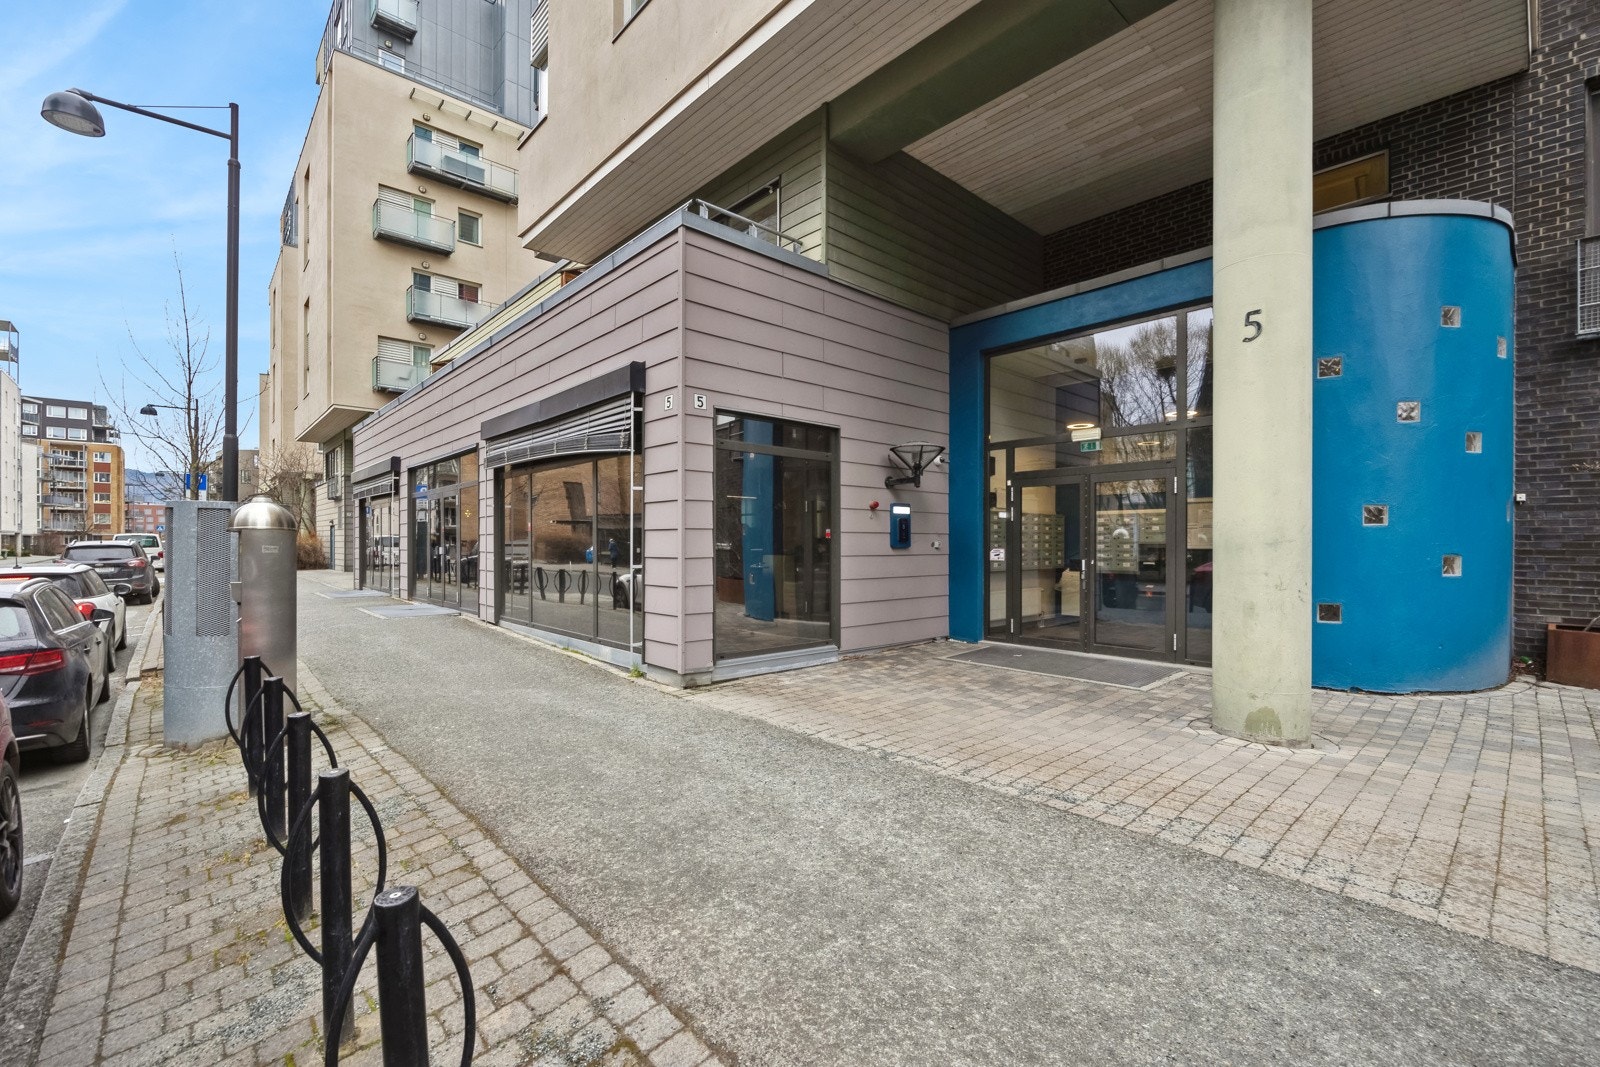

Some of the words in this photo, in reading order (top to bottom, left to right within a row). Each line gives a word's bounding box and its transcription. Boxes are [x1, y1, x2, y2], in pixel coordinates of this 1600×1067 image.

[1242, 308, 1263, 342] 5
[666, 396, 672, 408] 5
[697, 395, 704, 408] 5
